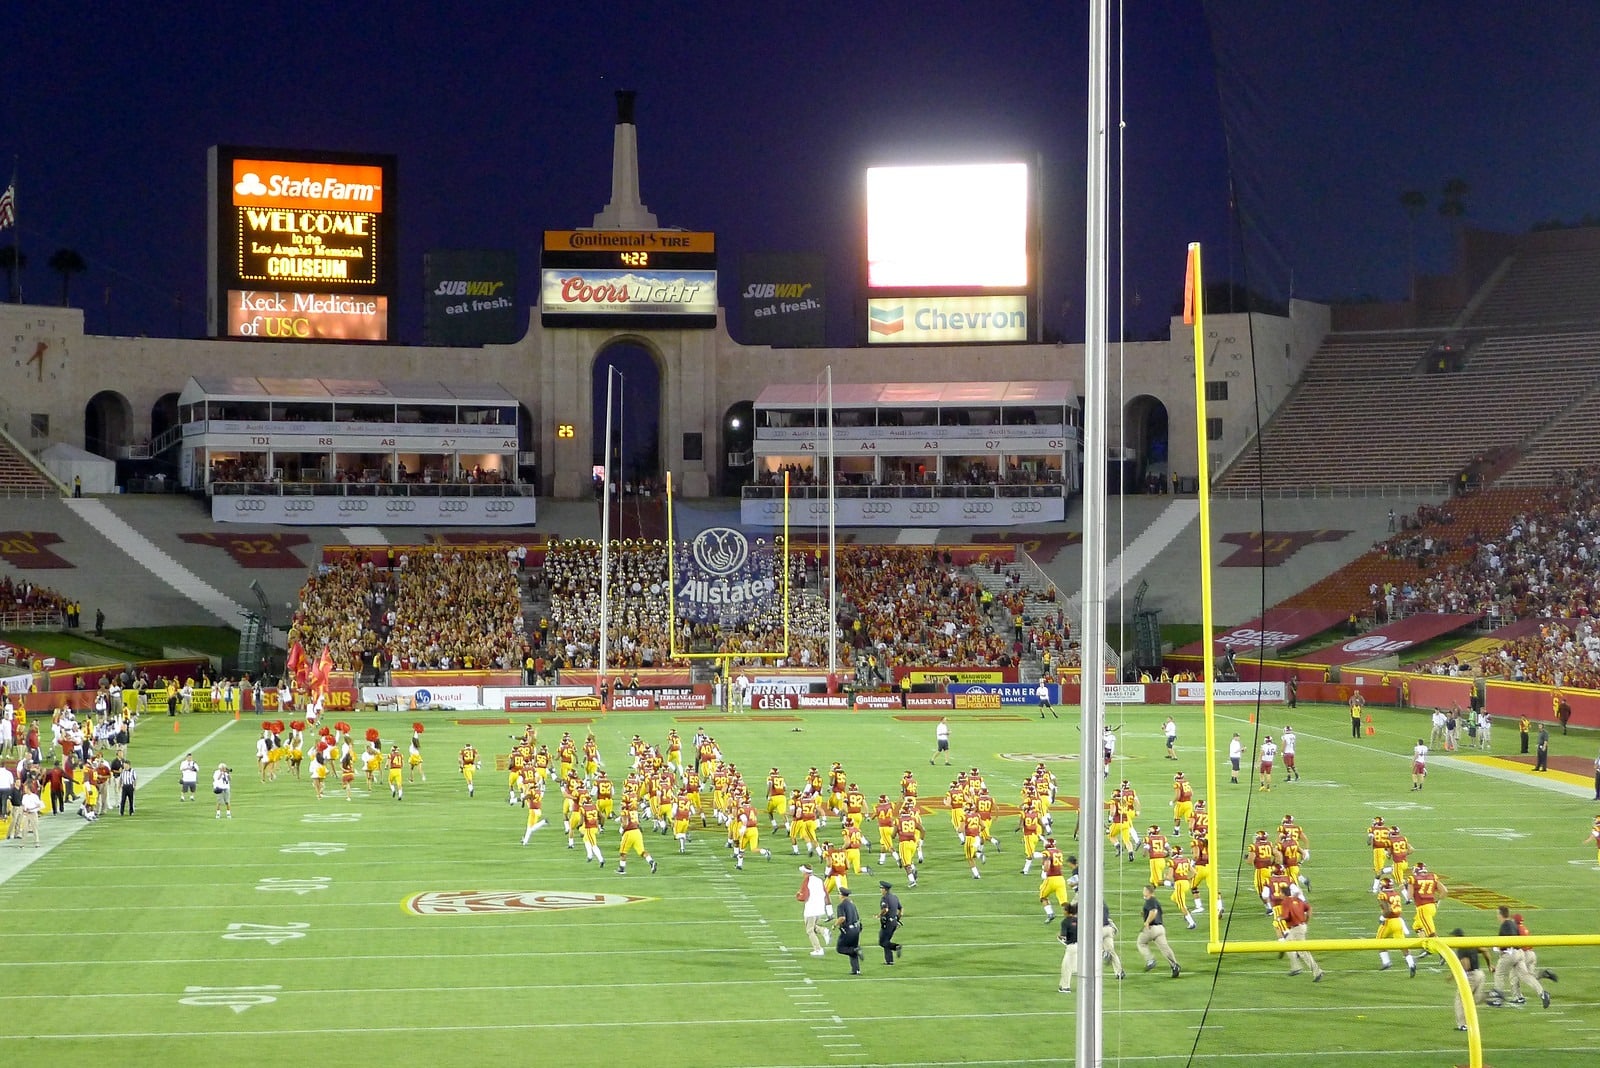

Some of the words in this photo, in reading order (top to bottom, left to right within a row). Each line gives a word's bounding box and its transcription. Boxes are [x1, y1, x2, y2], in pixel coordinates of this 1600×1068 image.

[246, 211, 369, 235] WELCOME
[292, 234, 303, 245] to
[305, 234, 322, 245] the
[569, 233, 645, 249] Continental
[662, 237, 691, 247] TIRE
[252, 242, 271, 254] Los
[273, 243, 312, 257] Angeles
[314, 245, 363, 258] Memorial
[620, 252, 649, 266] 4:22
[267, 257, 348, 279] COLISEUM
[434, 281, 504, 296] SUBWAY
[561, 276, 631, 303] Coors
[629, 285, 701, 303] LIGHT
[742, 282, 812, 298] SUBWAY
[240, 291, 286, 313] Keck
[292, 292, 377, 315] Medicine
[446, 302, 469, 314] eat
[754, 304, 777, 317] eat
[915, 307, 1025, 331] Chevron
[240, 316, 259, 337] of
[265, 319, 310, 338] USC
[558, 425, 574, 438] 25
[251, 437, 270, 445] TDI
[319, 437, 333, 446] R8
[800, 442, 815, 450] A5
[860, 442, 876, 450] A4
[924, 441, 939, 449] A3
[986, 441, 1000, 450] Q7
[1048, 440, 1064, 449] Q5
[231, 540, 280, 554] 32
[678, 579, 765, 604] Allstate
[1231, 629, 1300, 641] Office
[991, 688, 1038, 696] FARMER
[612, 696, 649, 710] jetBlue
[758, 694, 792, 709] dish
[856, 695, 895, 703] Continental
[968, 694, 1000, 703] CREATIVE
[464, 750, 474, 761] 31
[700, 745, 712, 755] 40
[392, 756, 402, 767] 41
[524, 770, 534, 781] 18
[600, 782, 611, 794] 62
[678, 800, 690, 812] 54
[850, 794, 862, 808] 92
[979, 800, 992, 812] 60
[802, 803, 815, 814] 57
[901, 820, 915, 833] 68
[1373, 830, 1388, 842] 85
[1153, 840, 1164, 852] 51
[1258, 844, 1271, 858] 50
[1284, 845, 1298, 859] 47
[1418, 882, 1433, 897] 77
